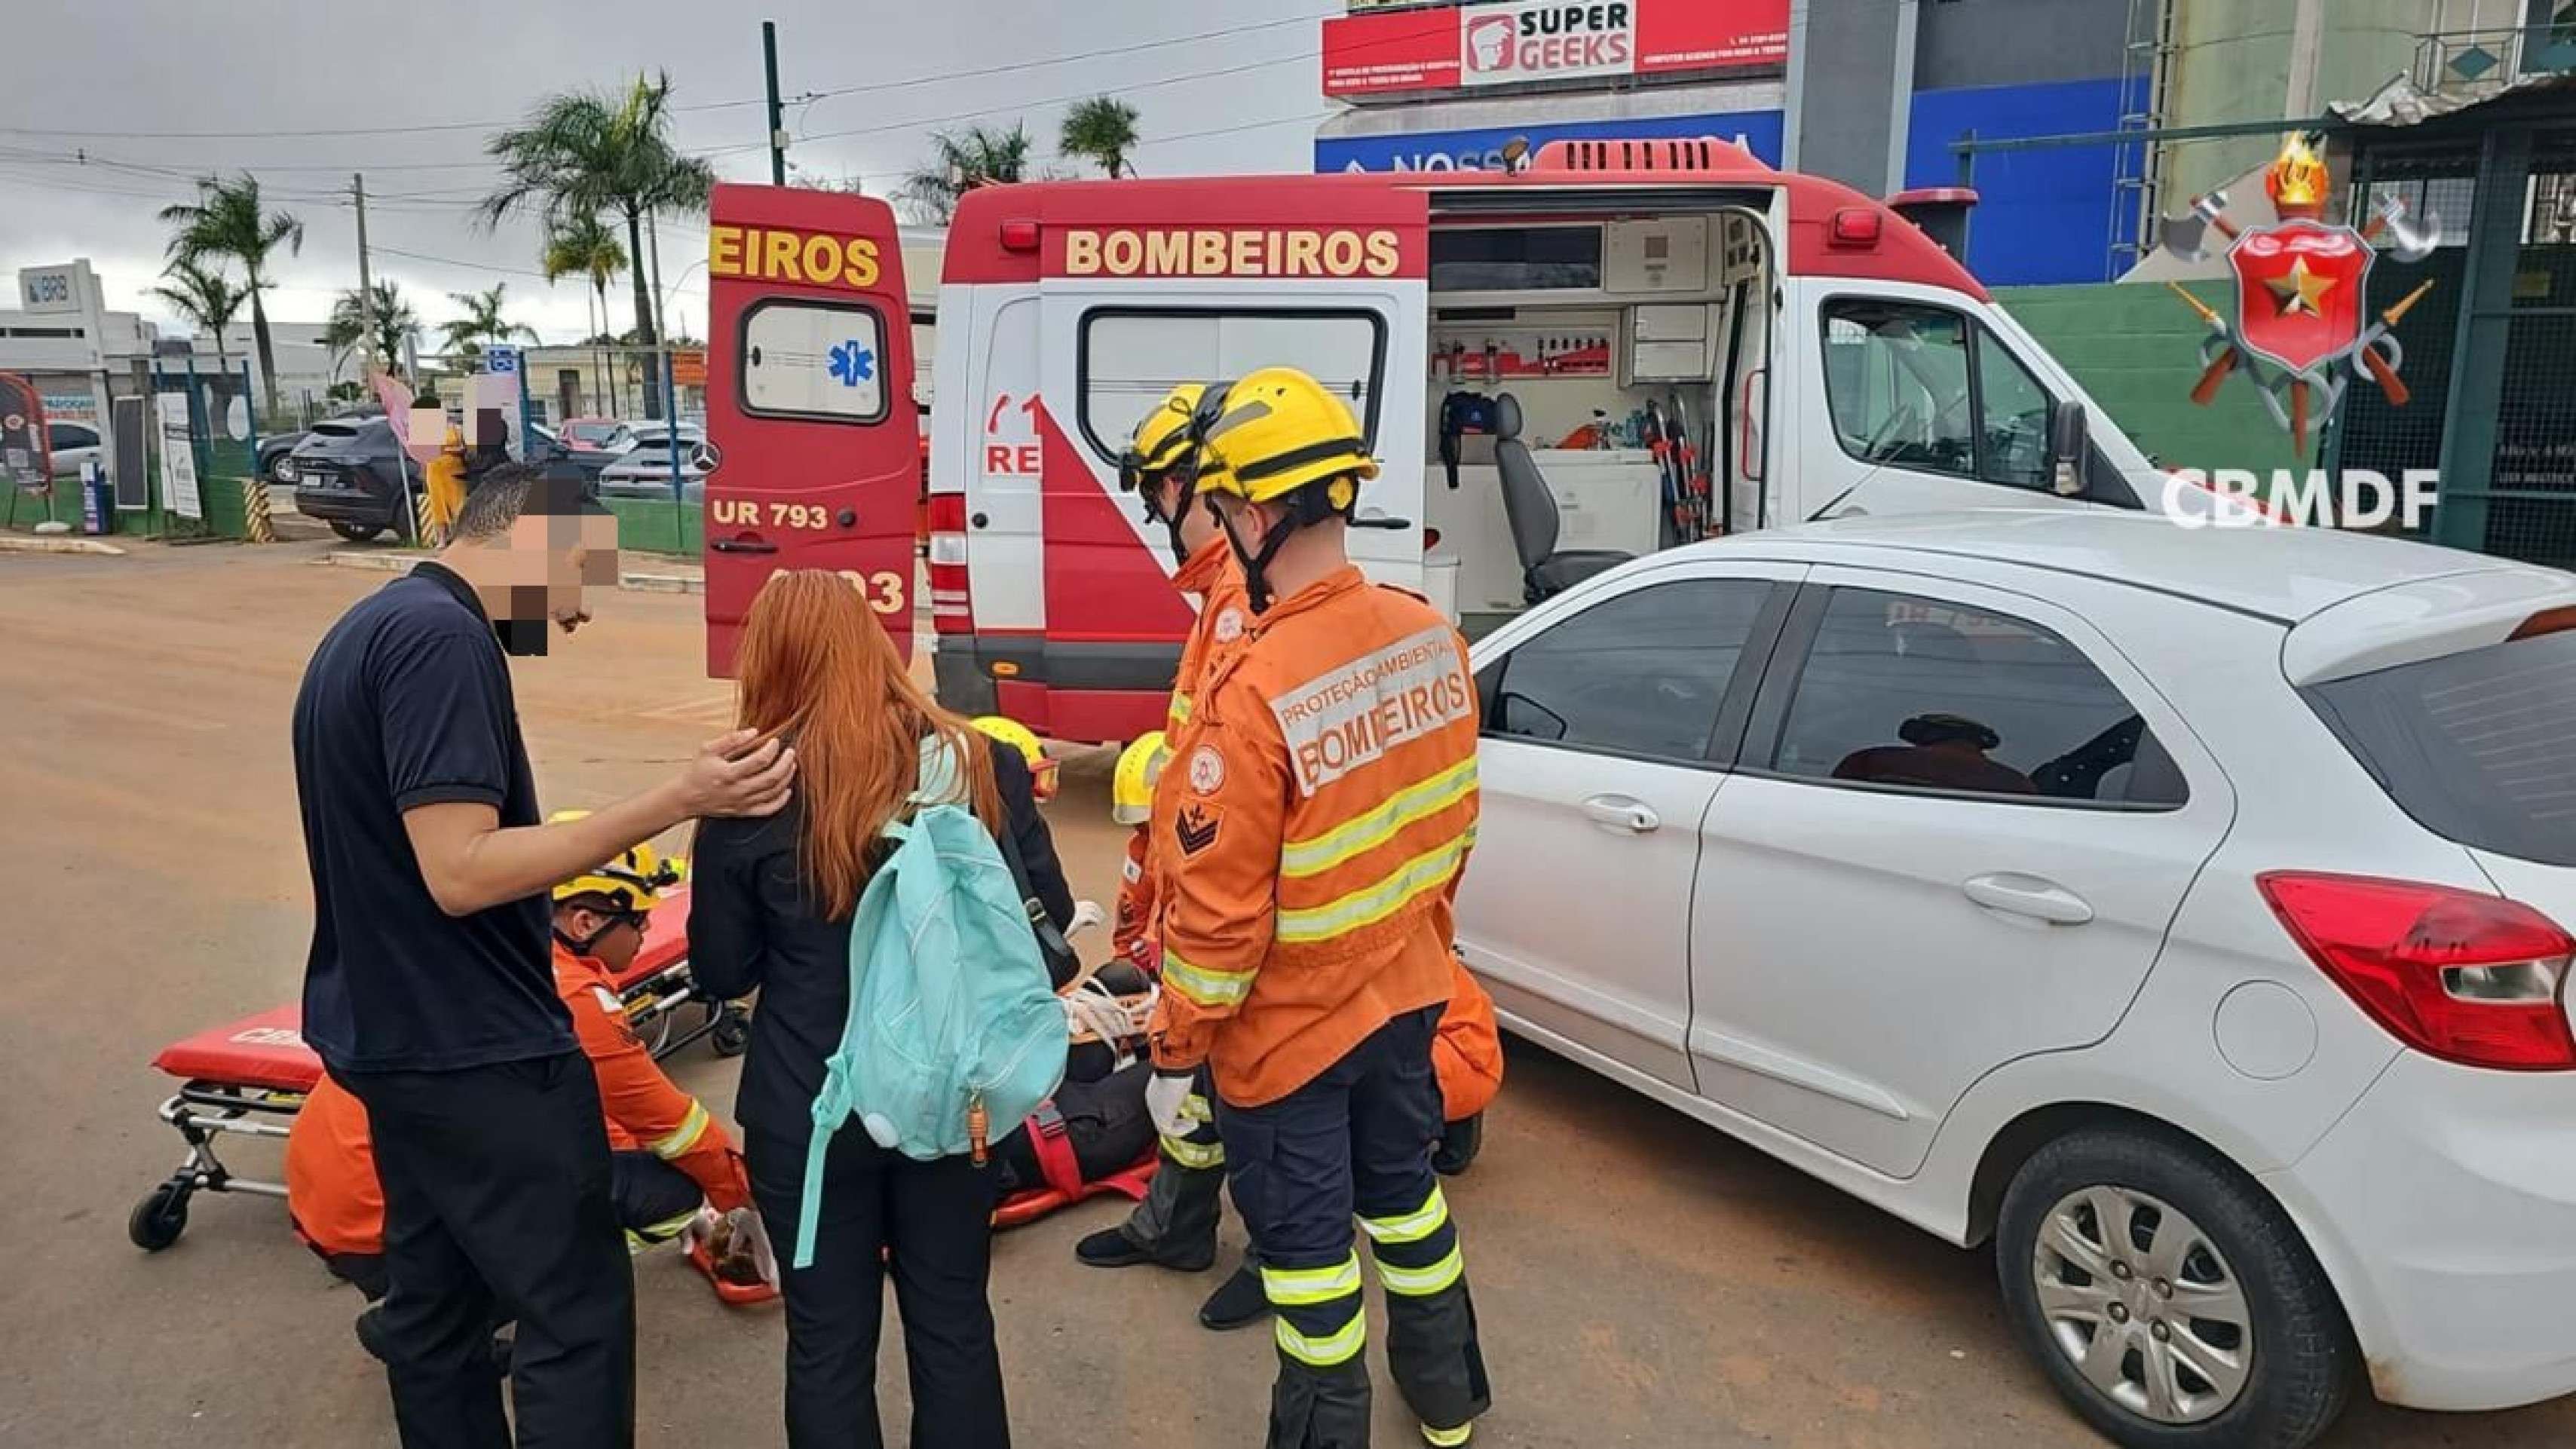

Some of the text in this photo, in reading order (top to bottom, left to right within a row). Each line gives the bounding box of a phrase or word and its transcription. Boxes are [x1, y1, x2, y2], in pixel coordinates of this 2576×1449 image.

[1520, 4, 1628, 36] SUPER
[1519, 33, 1627, 71] GEEKS
[709, 227, 878, 286] EIROS
[1066, 230, 1400, 275] BOMBEIROS
[714, 498, 828, 530] UR 793
